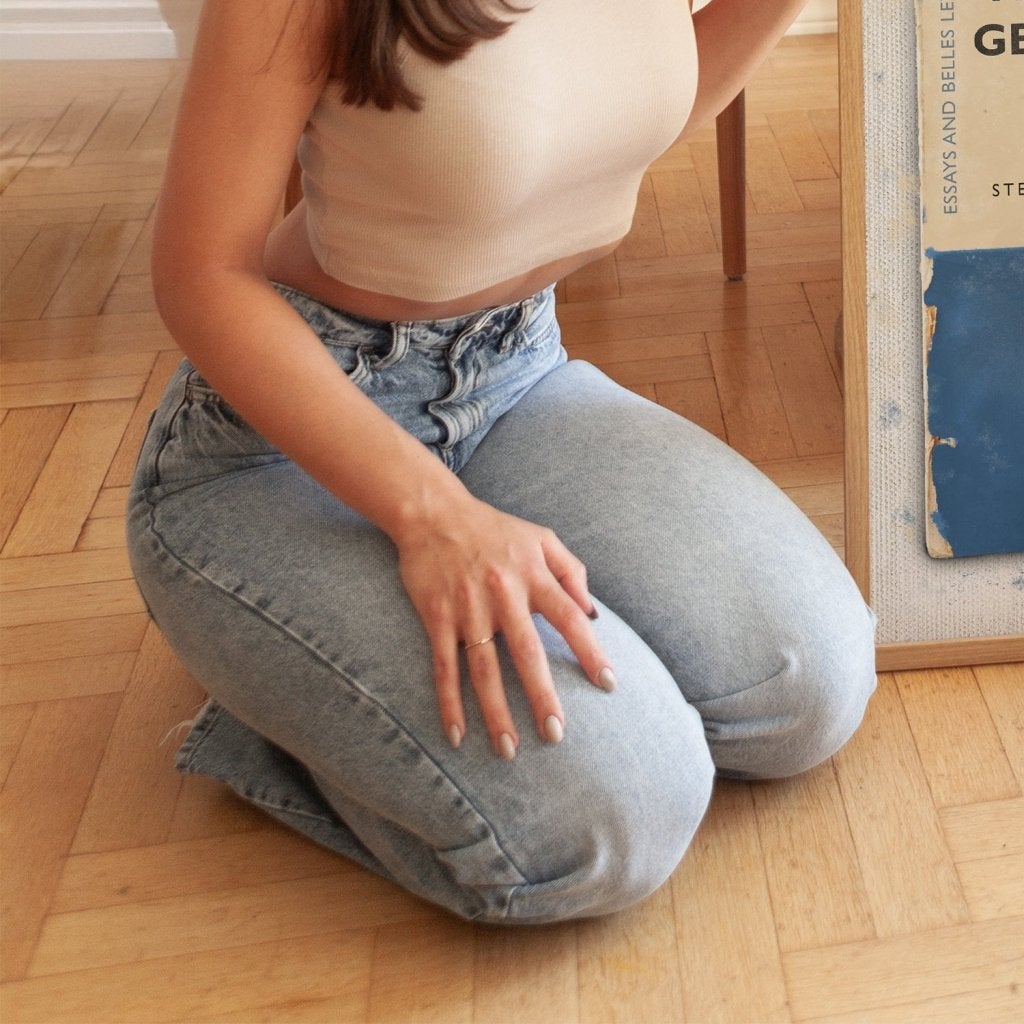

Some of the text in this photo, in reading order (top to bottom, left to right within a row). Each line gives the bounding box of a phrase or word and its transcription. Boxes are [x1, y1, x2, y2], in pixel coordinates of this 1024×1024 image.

[941, 30, 955, 92] BELLES
[942, 101, 956, 145] AND
[943, 151, 957, 214] ESSAYS
